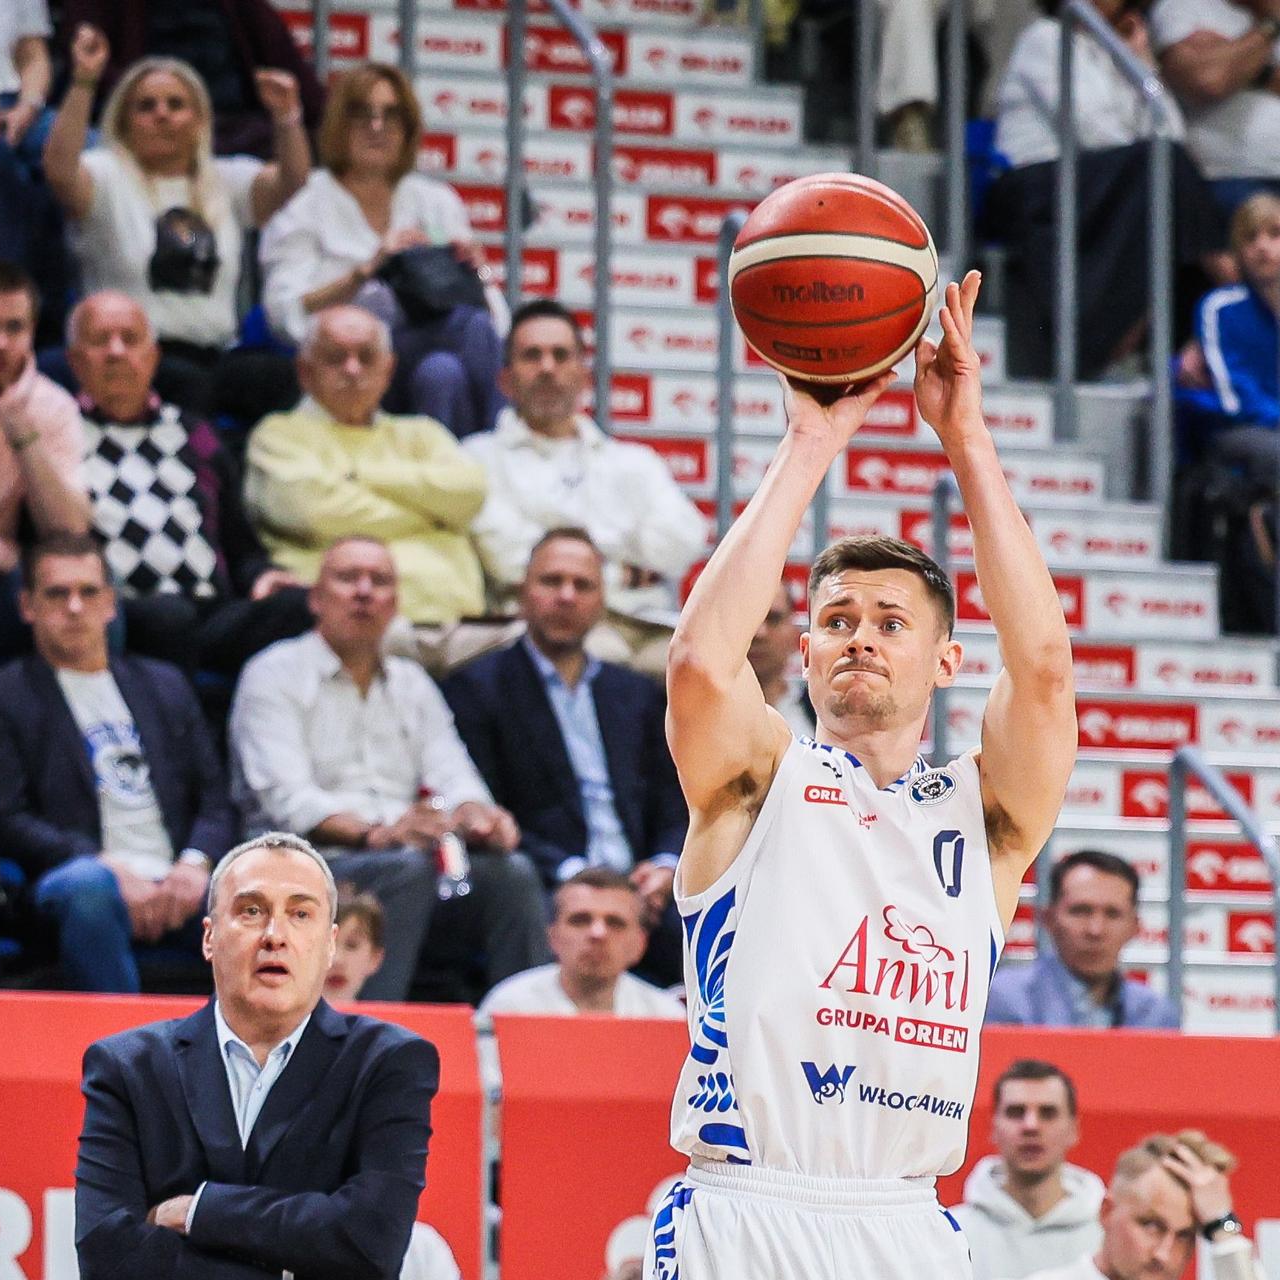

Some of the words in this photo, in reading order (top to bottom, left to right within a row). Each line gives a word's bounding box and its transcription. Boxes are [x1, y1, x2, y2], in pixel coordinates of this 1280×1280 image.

[772, 279, 864, 304] molten
[807, 787, 849, 801] ORL
[933, 830, 966, 898] 0
[818, 914, 970, 1012] Anwil
[816, 1007, 891, 1036] GRUPA
[898, 1020, 968, 1050] ORLEN
[859, 1084, 965, 1120] WŁOCAWEK
